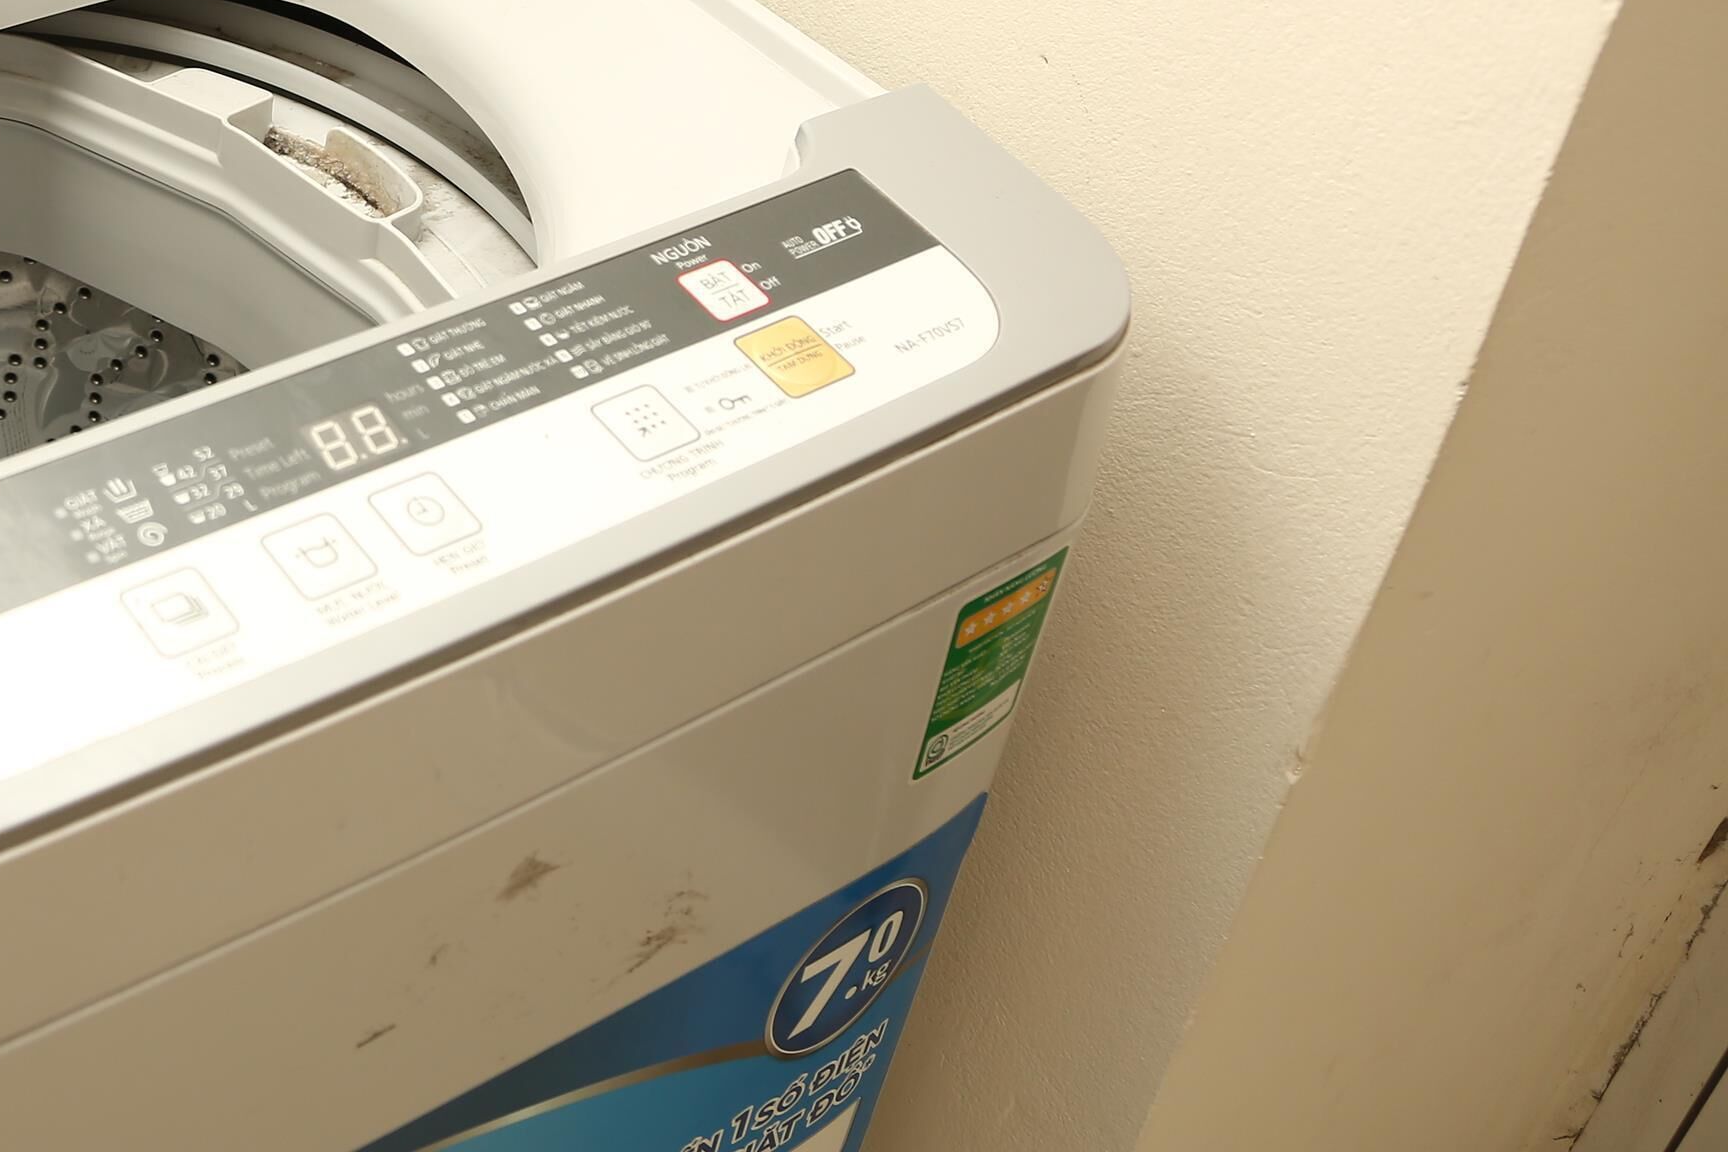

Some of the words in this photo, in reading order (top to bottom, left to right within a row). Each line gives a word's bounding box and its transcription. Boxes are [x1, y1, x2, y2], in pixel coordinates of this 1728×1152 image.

[812, 219, 847, 245] OFF
[650, 235, 712, 266] NGUỒN
[781, 235, 804, 249] AUTO
[789, 239, 819, 257] POWER
[675, 254, 709, 271] Power
[741, 259, 762, 275] On
[759, 275, 782, 291] Off
[819, 321, 854, 338] Start
[862, 960, 892, 992] kg
[751, 1072, 809, 1131] SỐ
[809, 1017, 890, 1097] ĐIỆN
